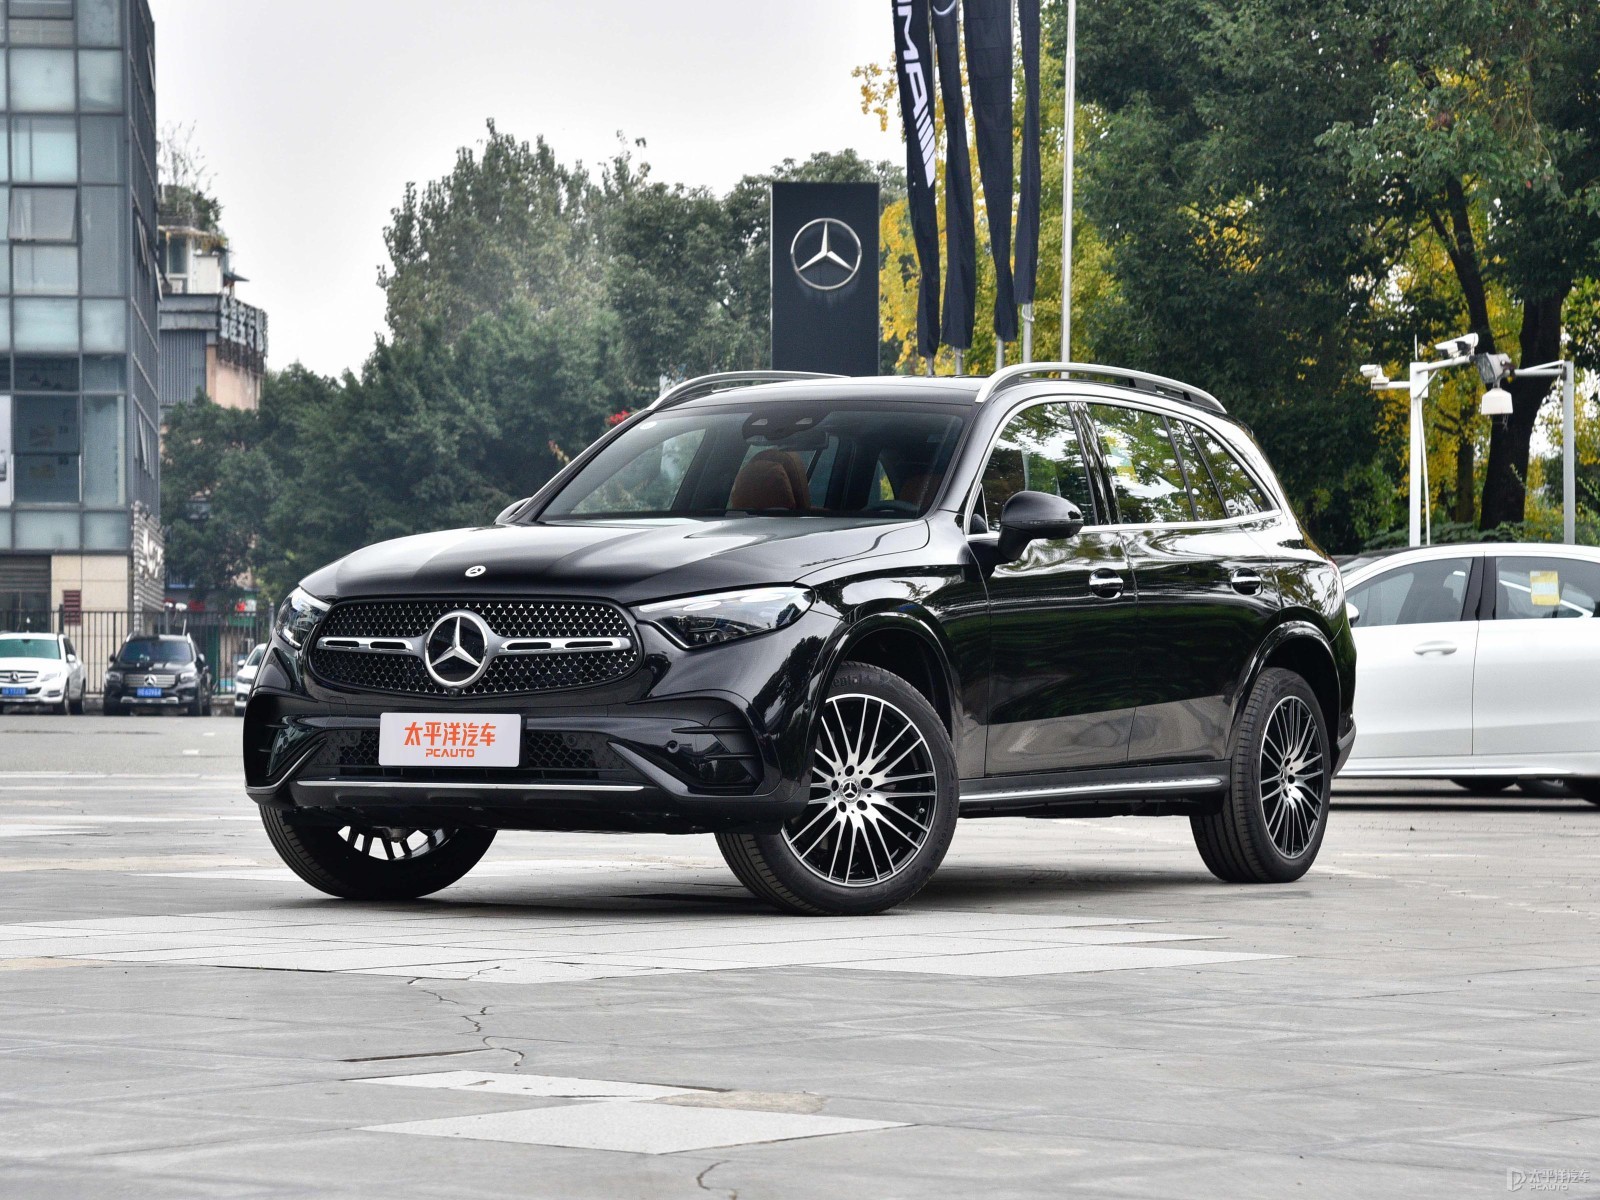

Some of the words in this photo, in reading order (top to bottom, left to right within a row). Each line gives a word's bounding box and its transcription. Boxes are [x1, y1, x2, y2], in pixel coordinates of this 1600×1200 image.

[403, 721, 497, 747] 太平洋汽车
[425, 748, 475, 758] PCAUTO
